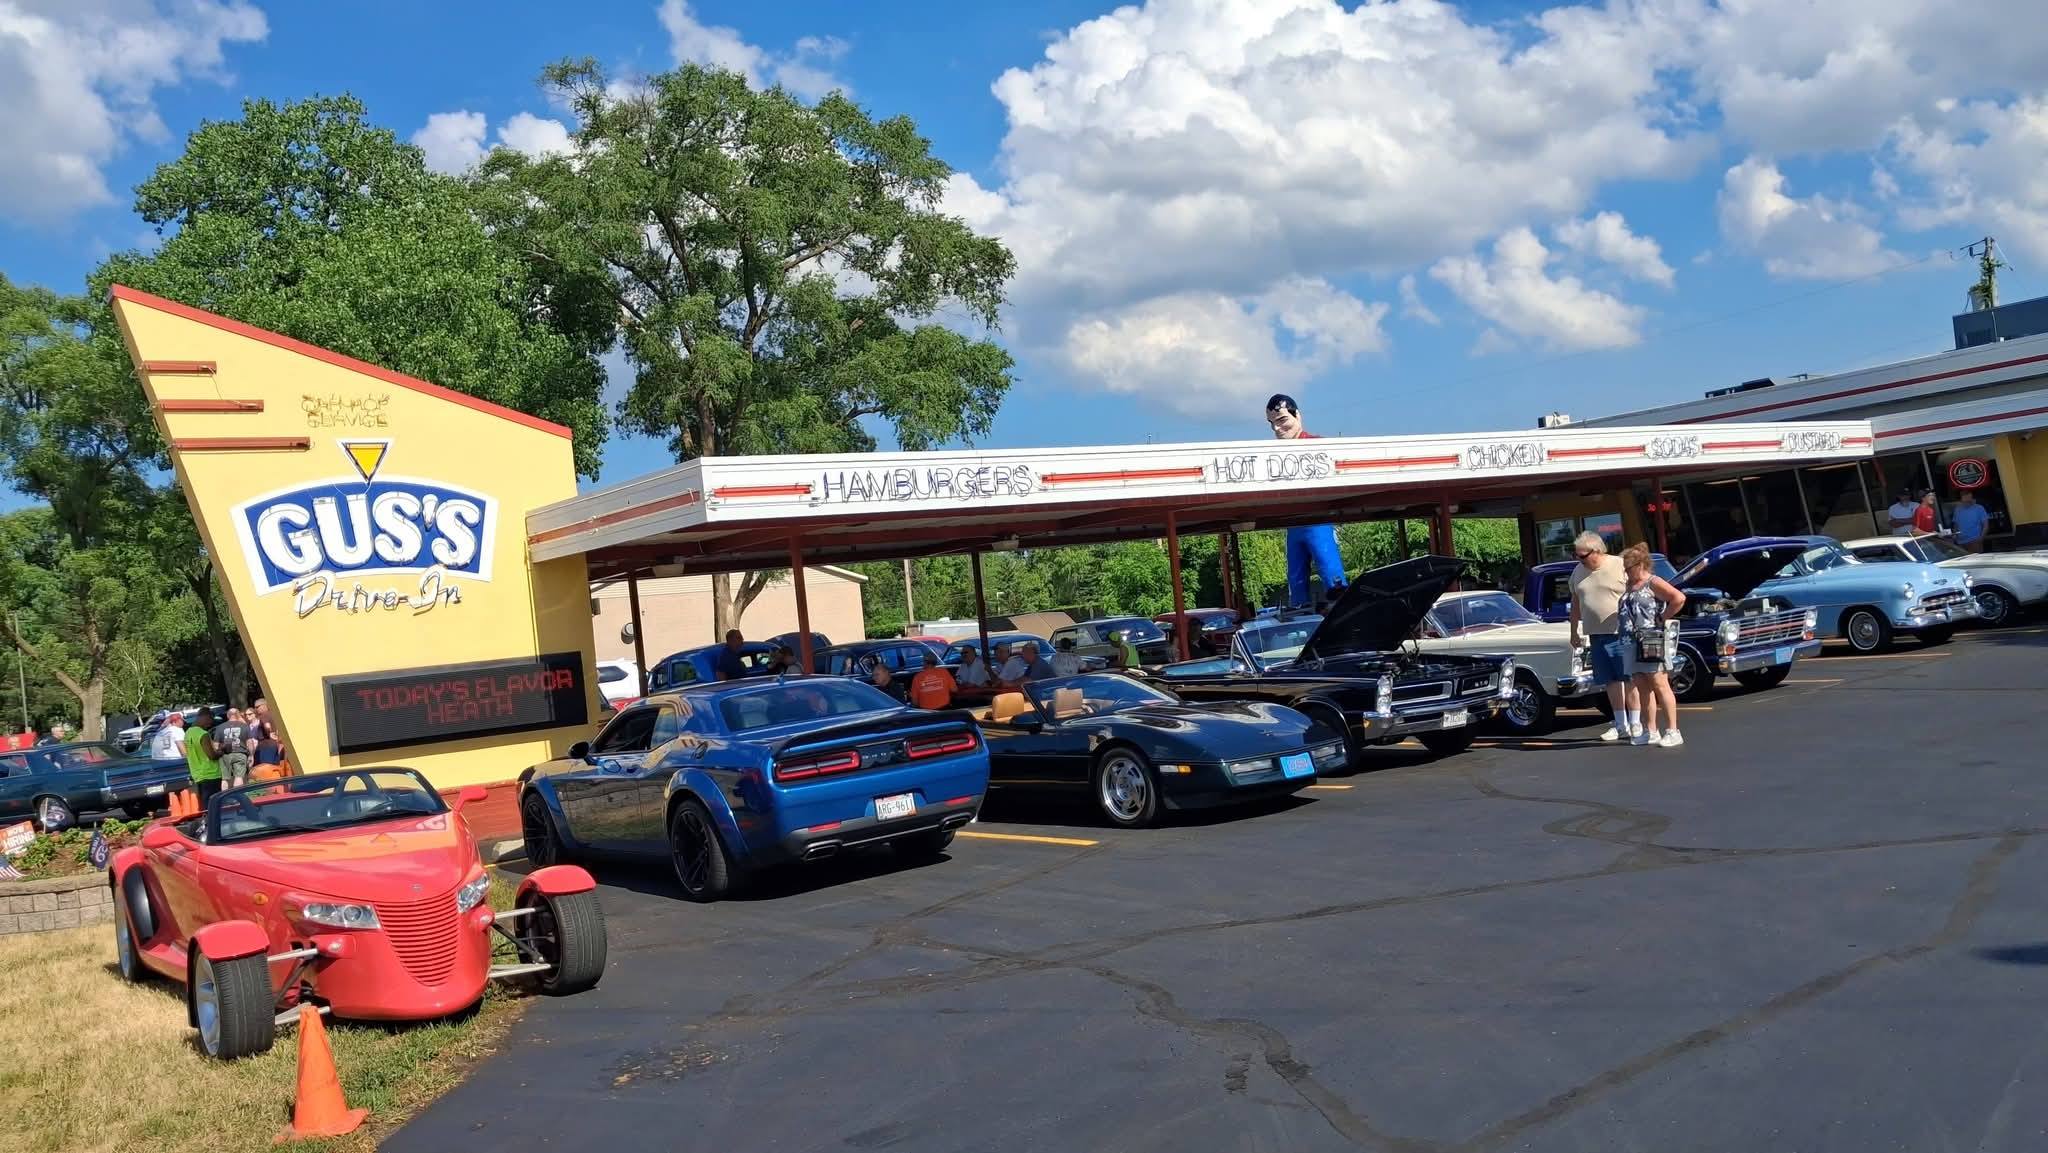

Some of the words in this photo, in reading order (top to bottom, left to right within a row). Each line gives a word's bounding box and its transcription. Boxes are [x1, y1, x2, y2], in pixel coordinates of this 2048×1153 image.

[1214, 456, 1257, 483] HOT
[1267, 452, 1331, 481] DOGS
[1467, 442, 1544, 471] CHICKEN
[822, 464, 1033, 503] HAMBURGERS
[257, 491, 480, 577] GUS'S
[292, 565, 462, 620] Drive-In
[356, 680, 470, 712] TODAY'S
[475, 668, 575, 700] FLAVOR
[427, 695, 513, 725] HEATH
